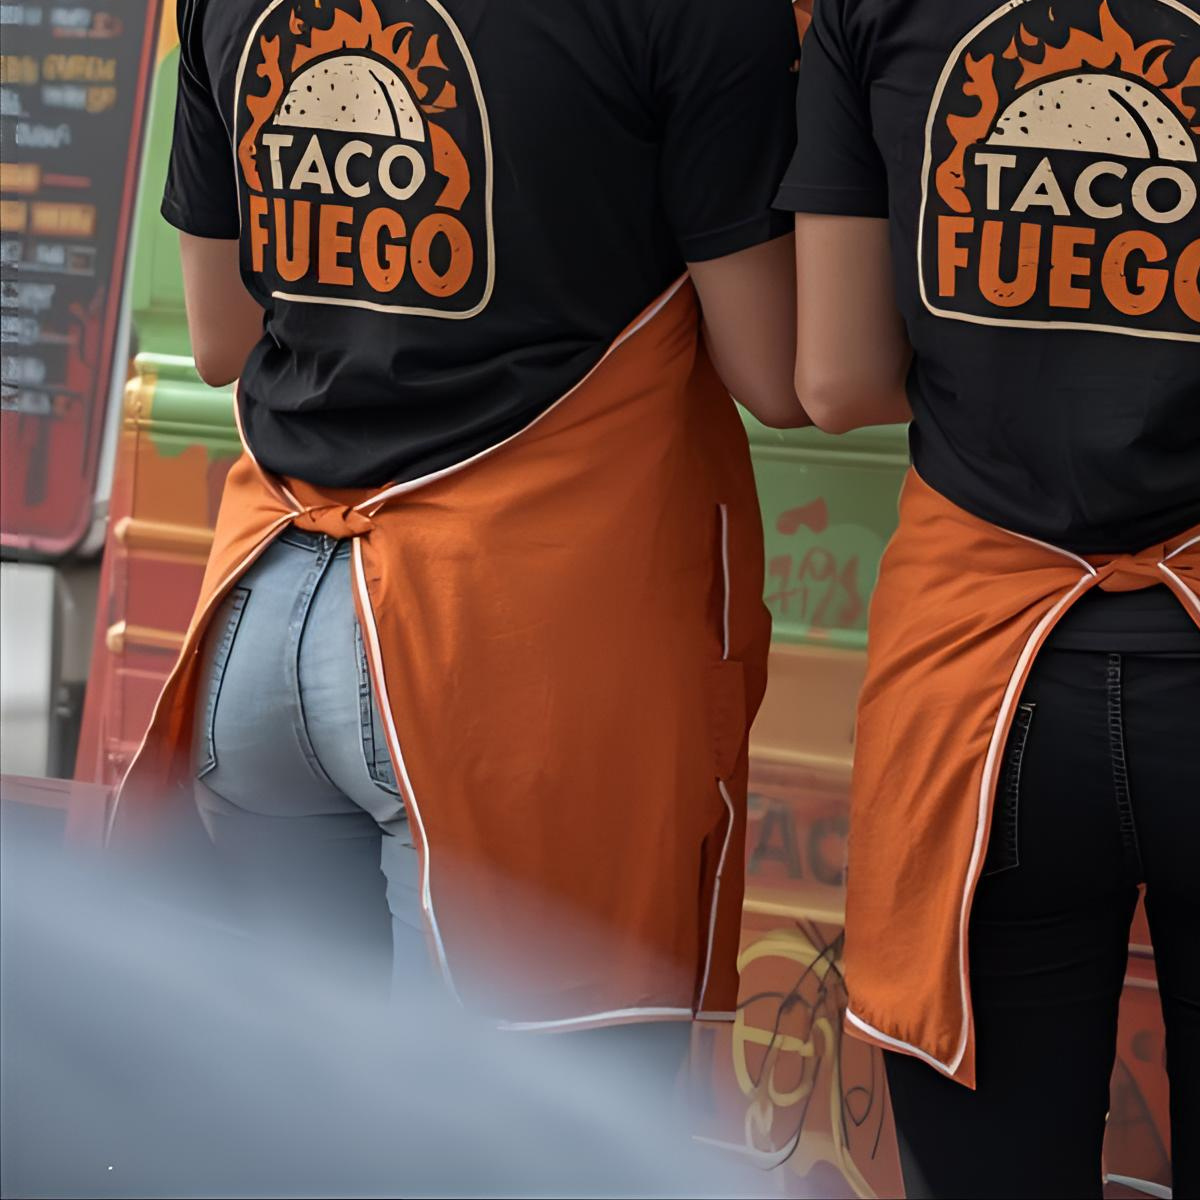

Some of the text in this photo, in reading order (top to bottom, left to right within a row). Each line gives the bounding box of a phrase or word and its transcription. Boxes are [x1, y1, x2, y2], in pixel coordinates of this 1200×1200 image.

[262, 133, 426, 201] TACO
[974, 152, 1197, 224] TACO
[250, 194, 474, 297] FUEGO
